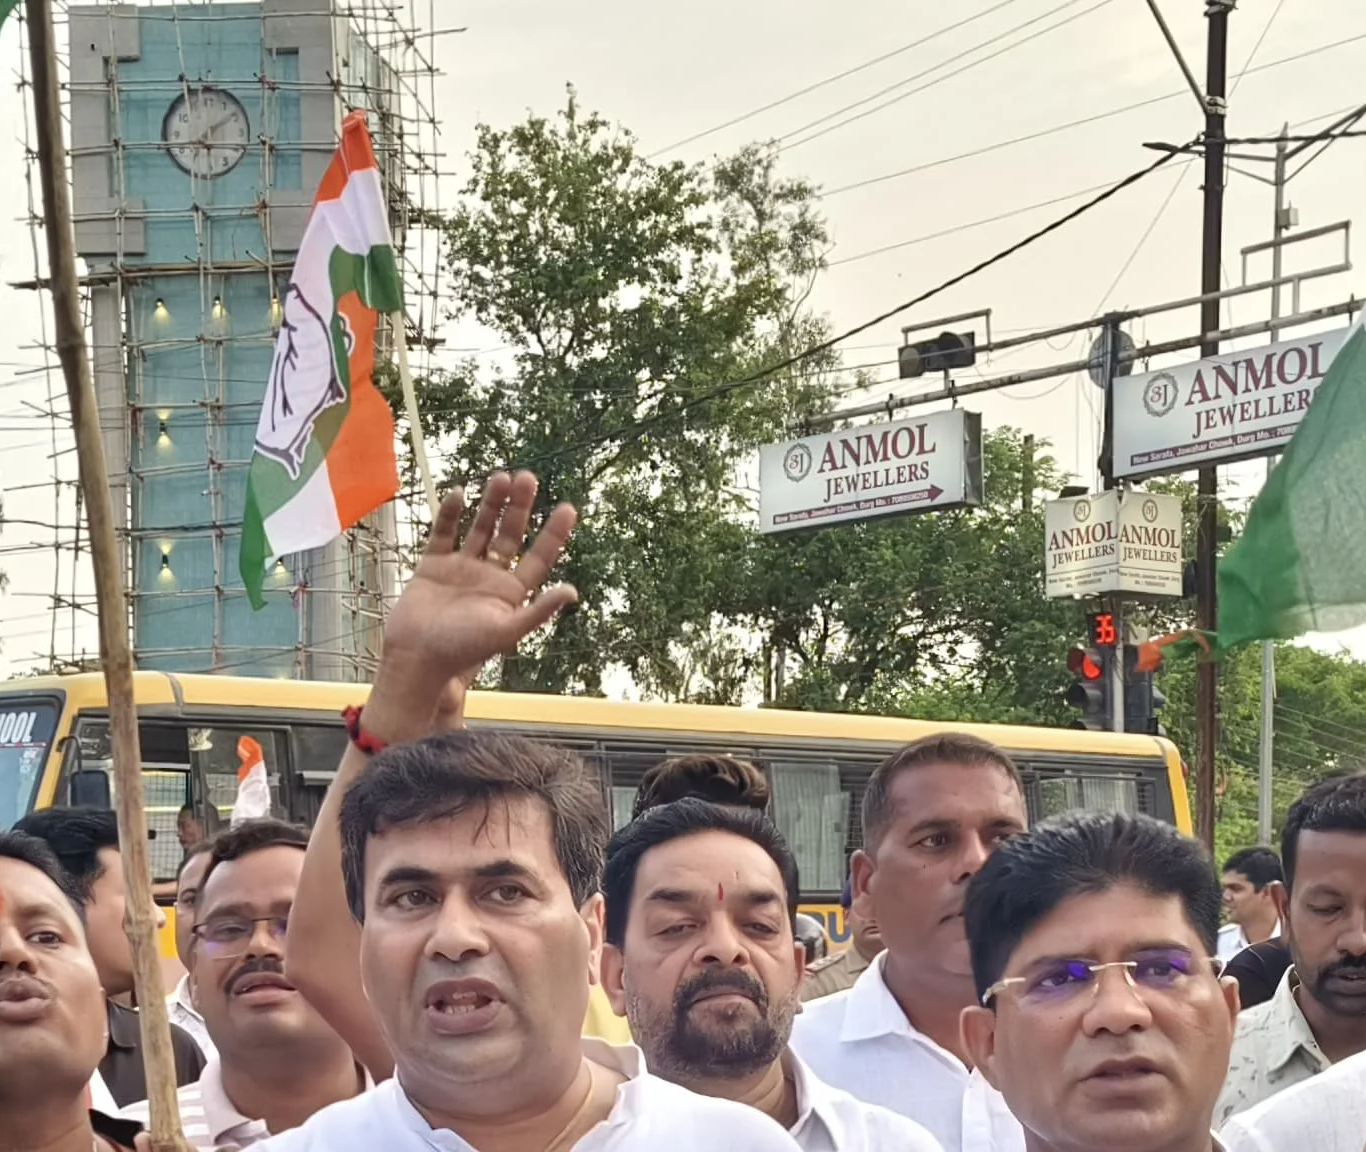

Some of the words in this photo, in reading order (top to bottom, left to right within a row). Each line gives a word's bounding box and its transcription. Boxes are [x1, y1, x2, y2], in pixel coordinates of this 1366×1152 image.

[1185, 341, 1327, 407] ANMOL
[1192, 386, 1316, 439] JEWELLER
[817, 423, 936, 474] ANMOL
[823, 461, 930, 502] JEWELLERS
[1048, 520, 1118, 552] ANMOL
[1119, 524, 1180, 549] ANMOL
[1052, 543, 1116, 569] JEWELLERS
[1122, 547, 1177, 563] JEWELLERS
